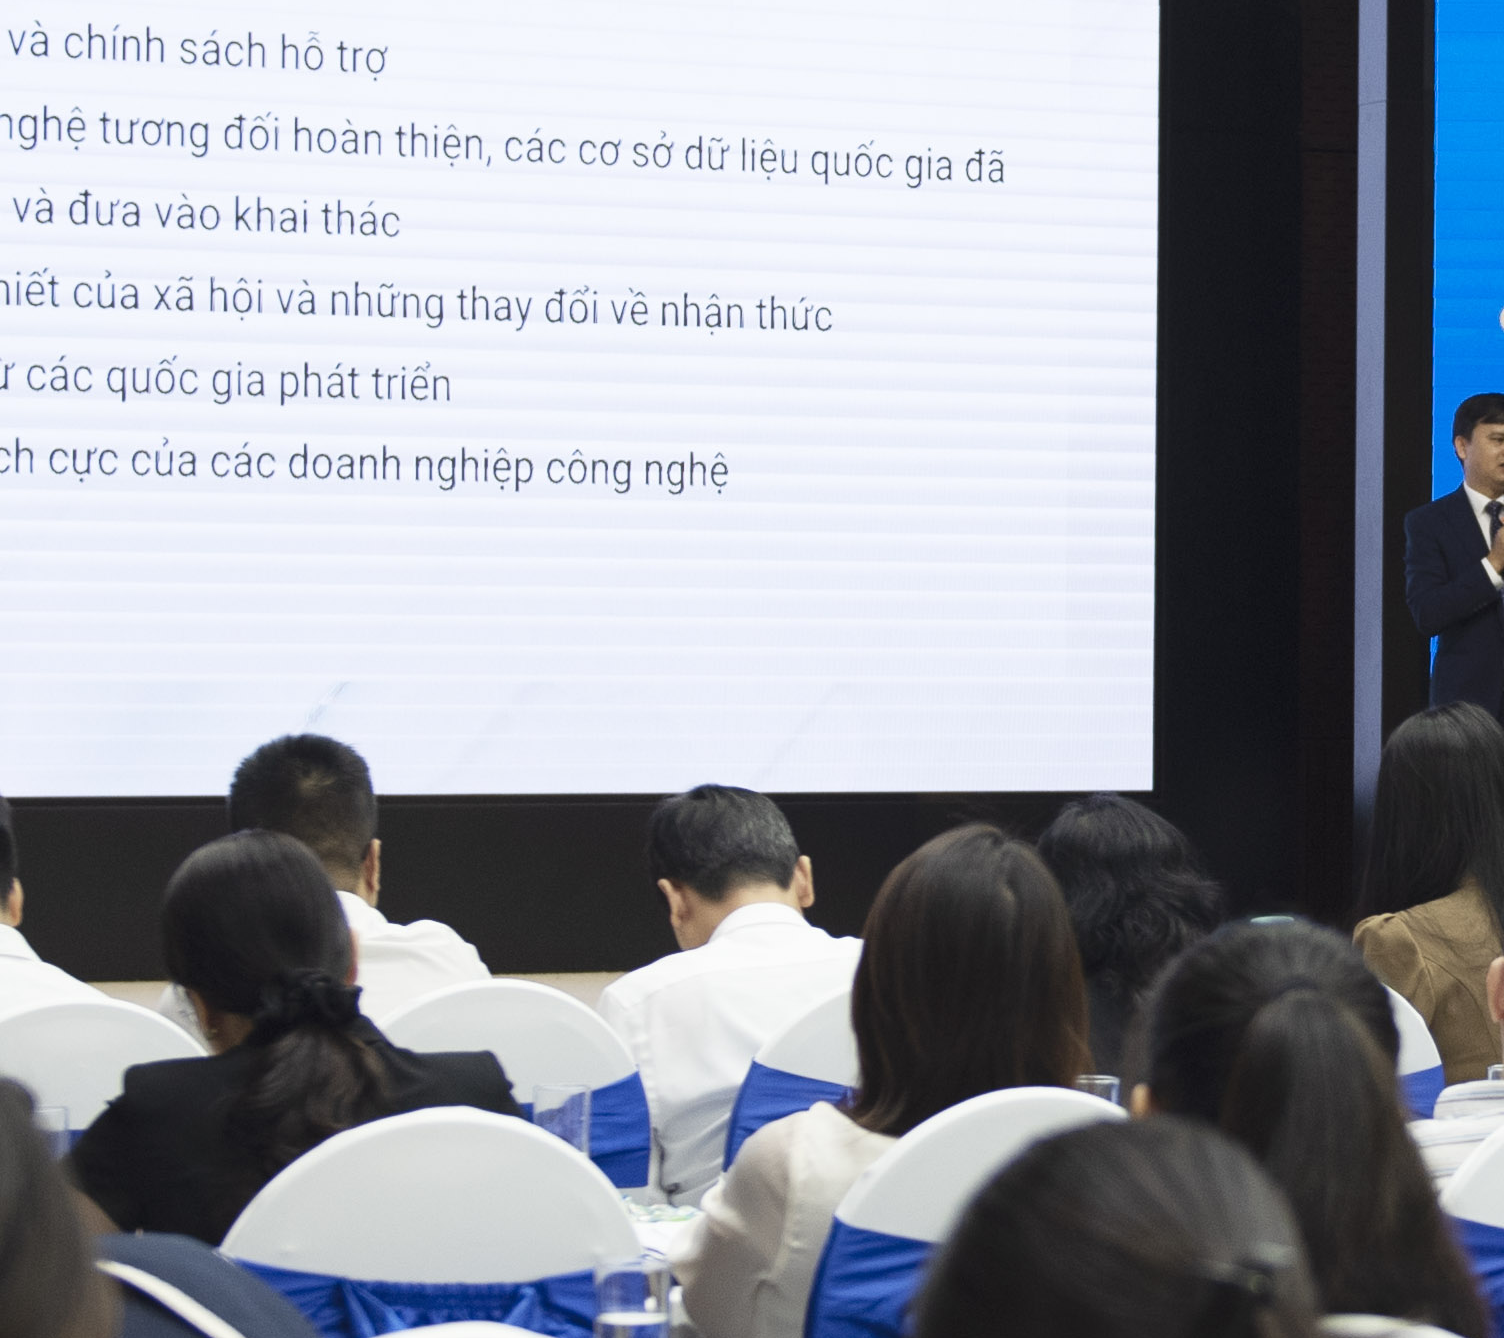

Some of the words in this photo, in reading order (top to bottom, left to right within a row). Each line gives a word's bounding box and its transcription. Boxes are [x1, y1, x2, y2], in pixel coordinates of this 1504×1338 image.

[8, 20, 48, 57] và
[65, 23, 164, 62] chính
[180, 30, 265, 68] sách
[282, 32, 323, 71] hỗ
[337, 41, 388, 81] trợ
[99, 112, 208, 158] tương
[224, 113, 278, 150] đối
[295, 117, 381, 155] hoàn
[395, 122, 491, 167] thiện,
[505, 128, 565, 163] các
[579, 140, 621, 166] cơ
[633, 131, 674, 168] sở
[685, 136, 730, 170] dữ
[742, 137, 797, 180] liệu
[811, 140, 893, 185] quốc
[906, 148, 952, 188] gia
[966, 149, 1004, 183] đã
[13, 188, 53, 224] và
[69, 189, 140, 227] đưa
[155, 193, 220, 230] vào
[235, 196, 307, 233] khai
[321, 200, 399, 237] thác
[74, 270, 139, 309] của
[154, 277, 194, 311] xã
[210, 277, 262, 321] hội
[277, 280, 316, 315] và
[331, 281, 443, 328] những
[457, 285, 532, 331] thay
[545, 285, 597, 324] đổi
[611, 288, 648, 326] về
[662, 293, 744, 335] nhận
[756, 296, 832, 332] thức
[27, 355, 92, 392] các
[107, 355, 198, 402] quốc
[213, 362, 264, 405] gia
[281, 362, 359, 406] phát
[372, 362, 450, 401] triển
[49, 448, 118, 483] cực
[132, 437, 196, 477] của
[211, 442, 275, 478] các
[289, 443, 400, 480] doanh
[416, 447, 533, 492] nghiệp
[547, 449, 631, 494] công
[646, 452, 728, 495] nghệ
